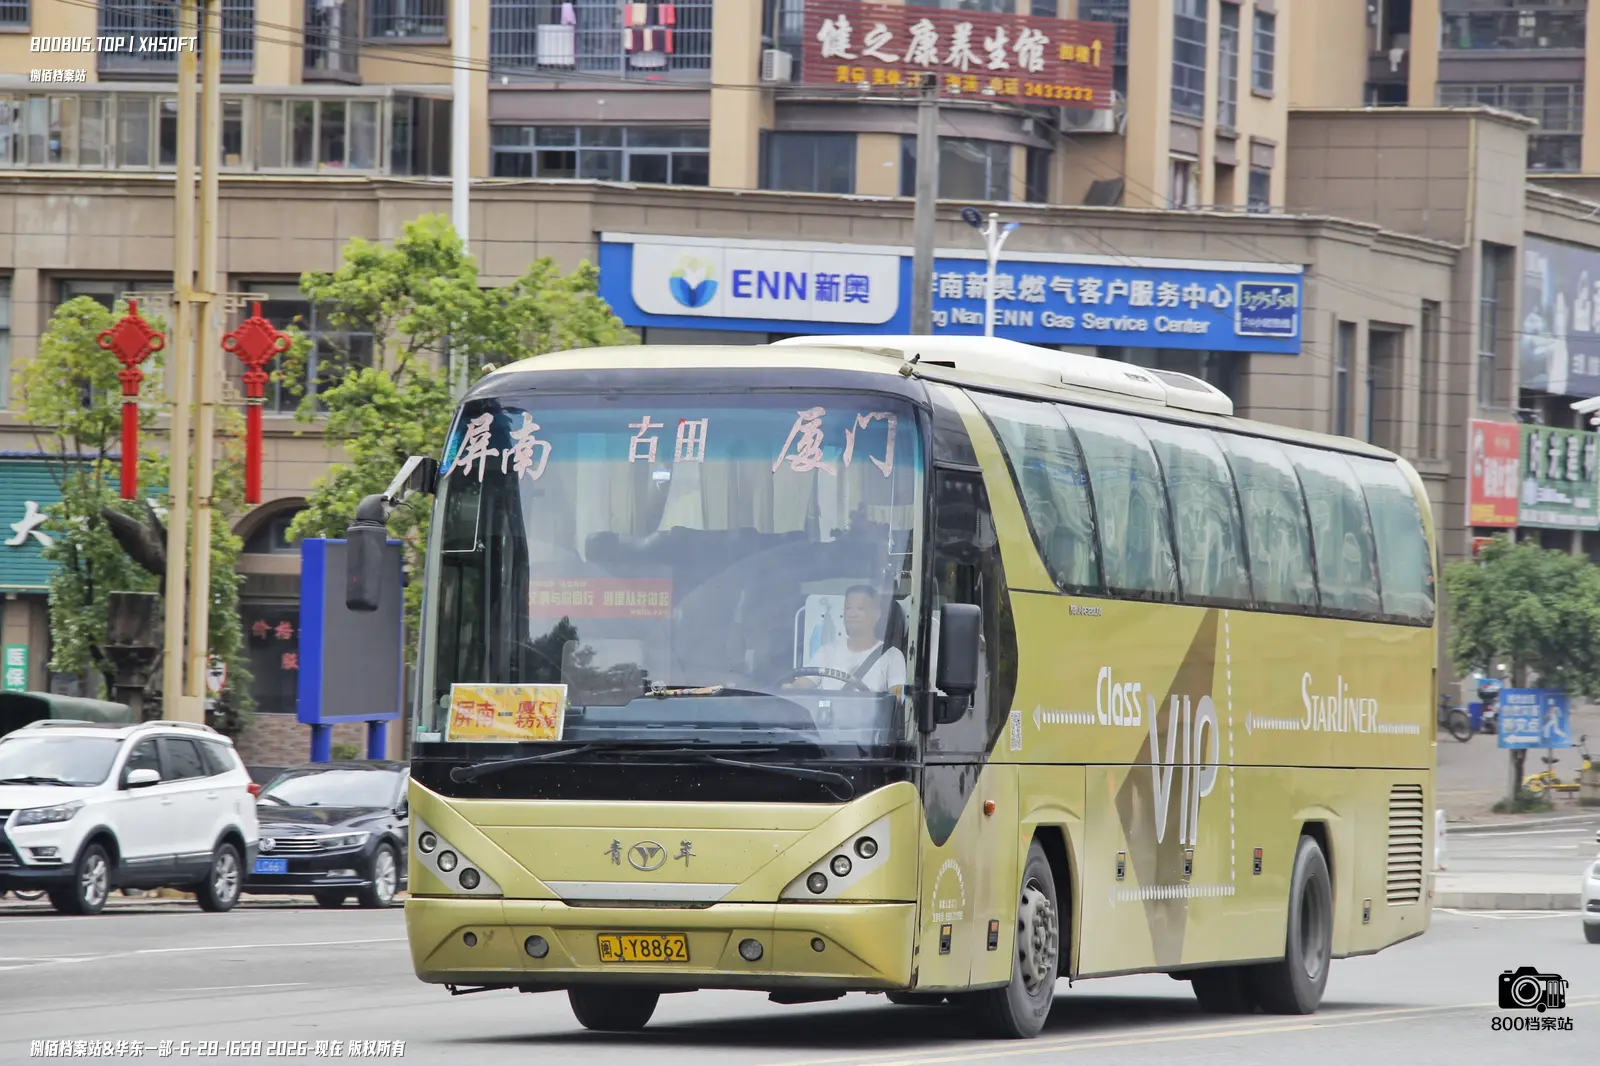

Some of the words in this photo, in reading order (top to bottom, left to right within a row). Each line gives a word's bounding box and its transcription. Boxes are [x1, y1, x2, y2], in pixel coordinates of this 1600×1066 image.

[817, 14, 1049, 73] 健之康养生馆
[732, 269, 808, 300] ENN
[814, 272, 871, 304] 新奥
[993, 308, 1034, 327] ENN
[1040, 311, 1075, 329] Gas
[1082, 313, 1148, 332] Service
[1154, 315, 1211, 335] Center
[444, 411, 552, 483] 屏南
[628, 415, 709, 464] 古田
[772, 406, 897, 478] 厦门
[1097, 666, 1142, 727] Class
[1146, 693, 1220, 846] VIP
